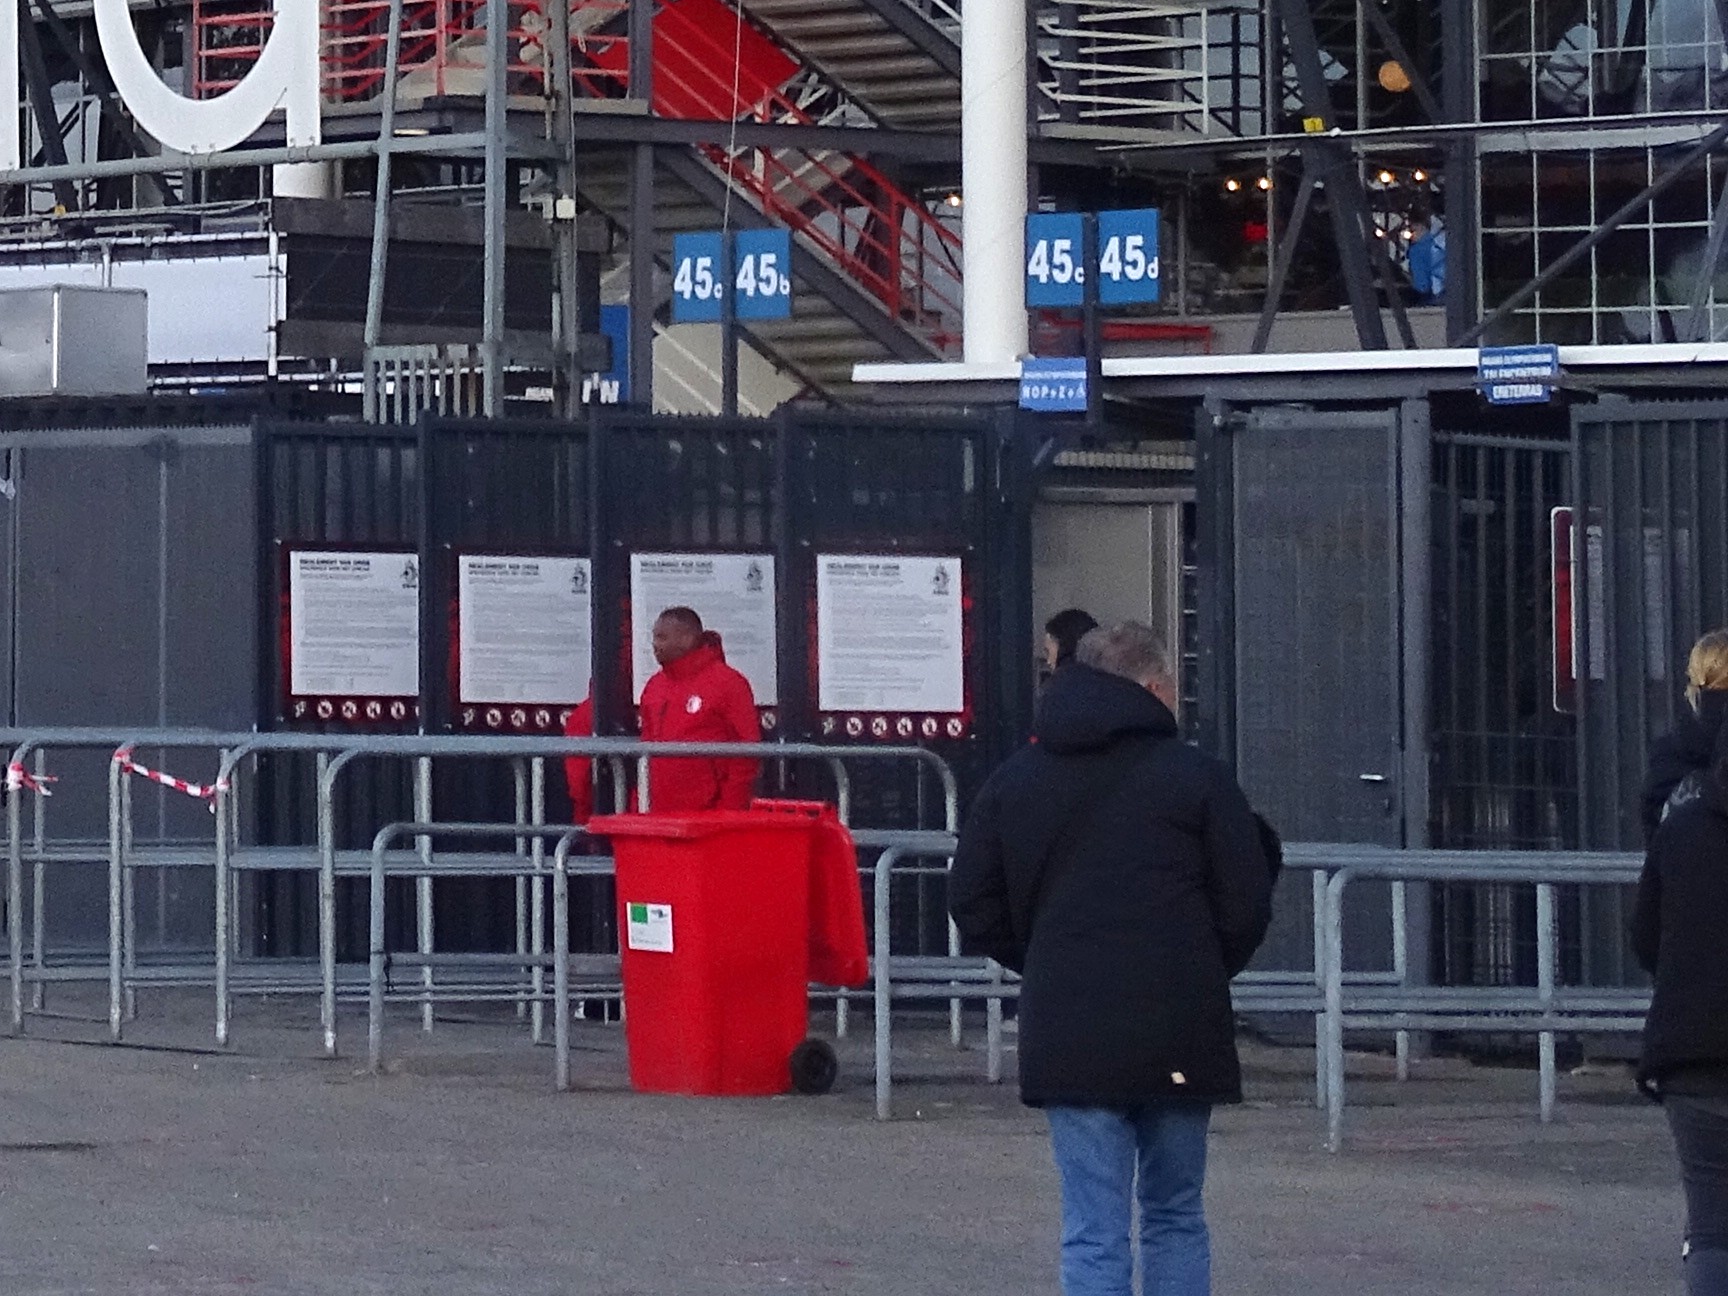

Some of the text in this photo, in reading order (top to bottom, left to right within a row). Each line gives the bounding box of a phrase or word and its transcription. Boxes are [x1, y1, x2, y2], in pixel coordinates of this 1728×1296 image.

[736, 253, 790, 297] 45b
[1028, 239, 1084, 283] 45c
[1100, 235, 1159, 281] 45d
